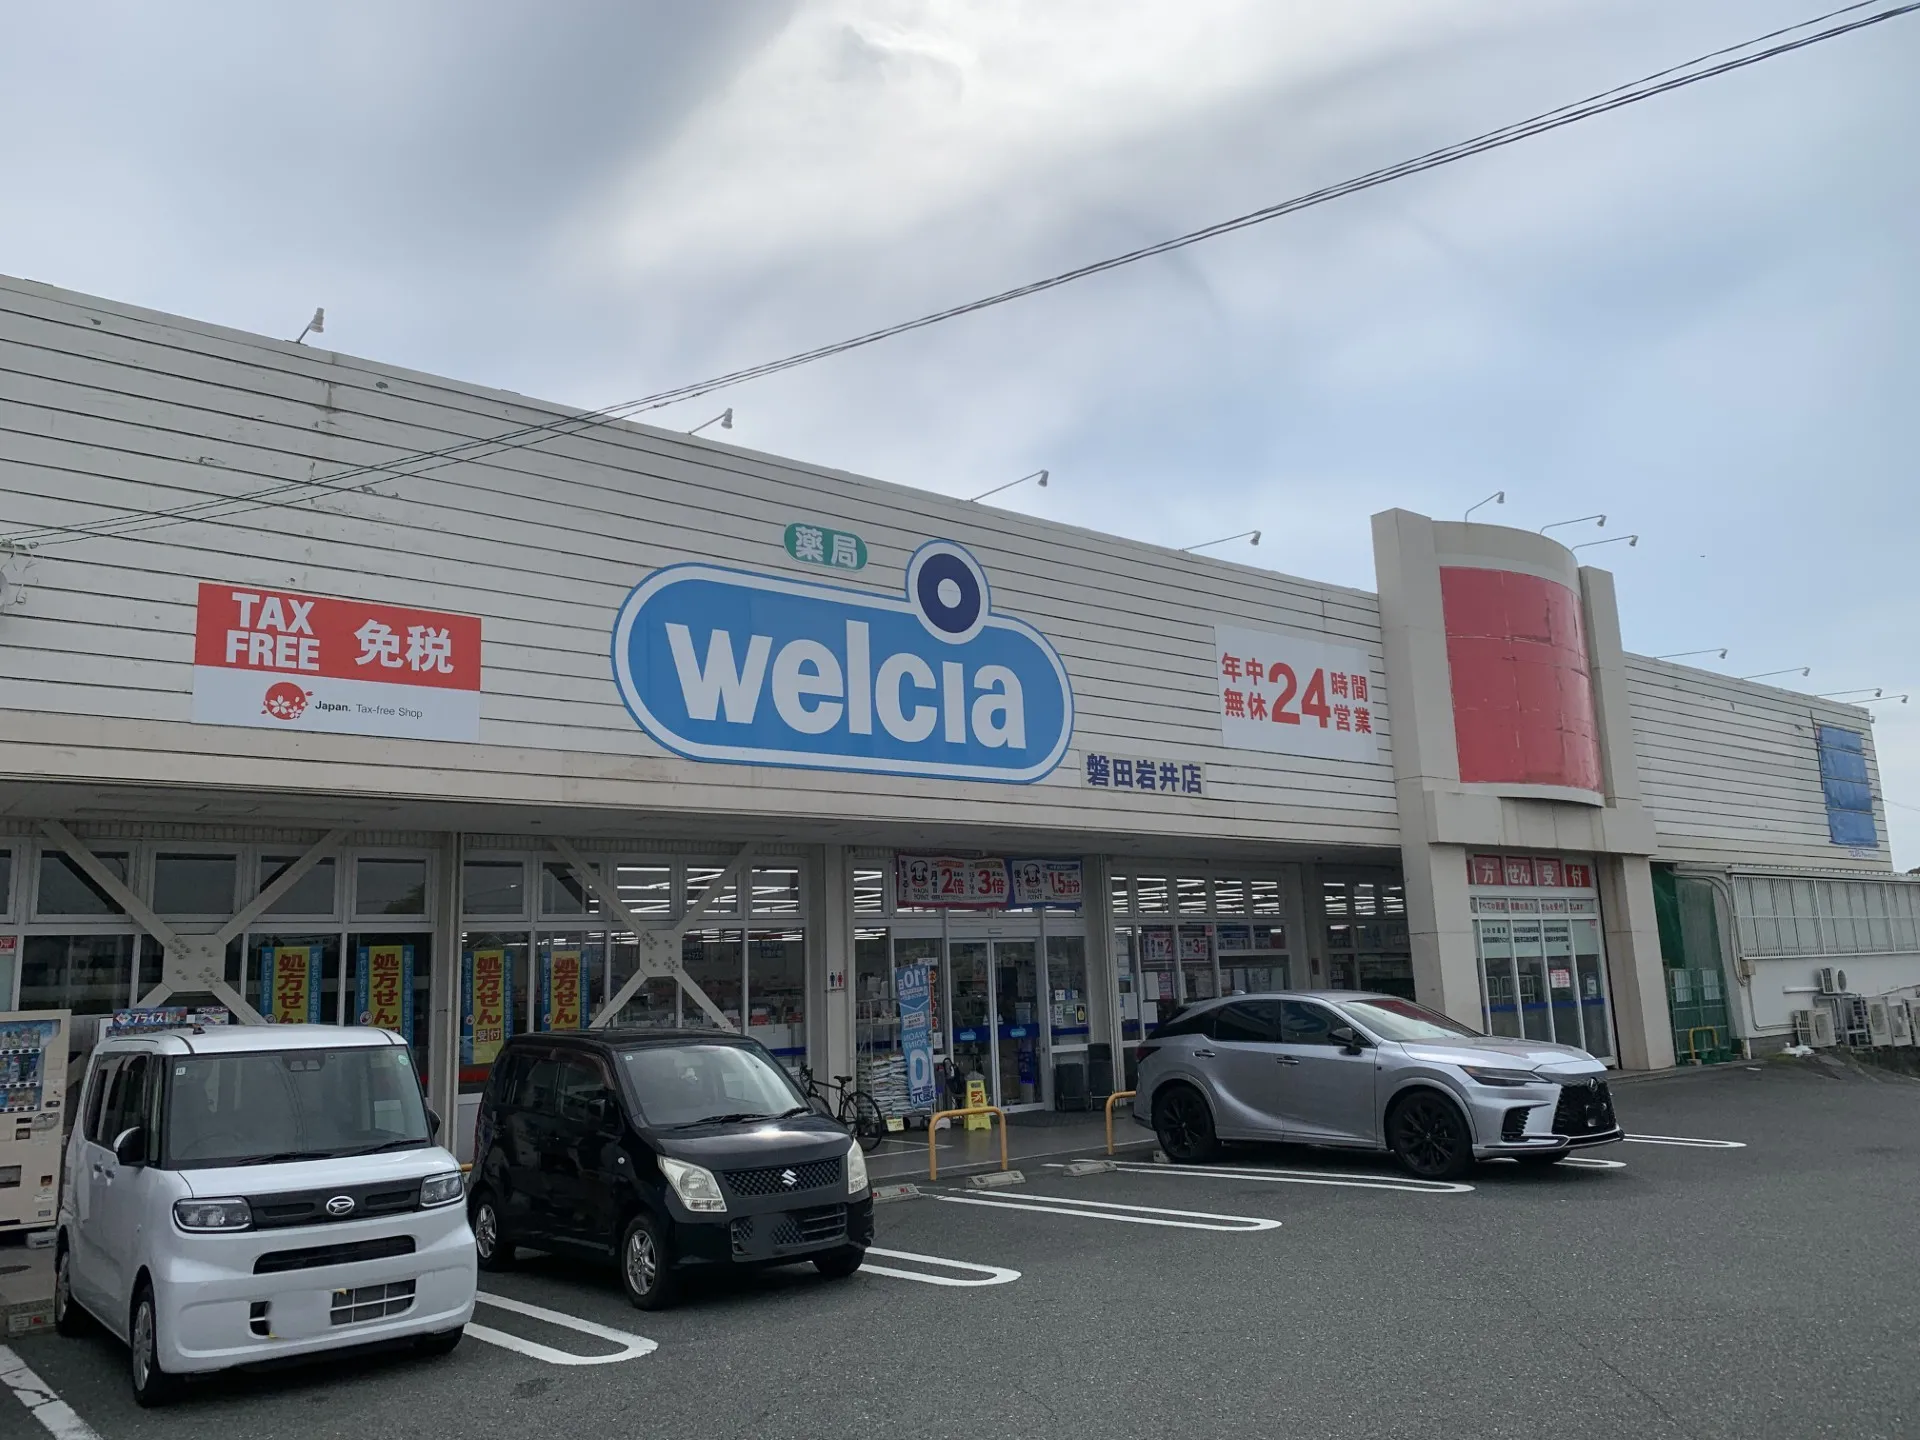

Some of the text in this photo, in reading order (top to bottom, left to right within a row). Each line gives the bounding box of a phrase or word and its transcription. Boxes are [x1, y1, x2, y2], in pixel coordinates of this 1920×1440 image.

[794, 527, 858, 567] 薬局
[232, 591, 315, 635] TAX
[225, 631, 321, 671] FREE
[354, 619, 455, 675] 免税
[665, 555, 1028, 750] welcia
[1221, 652, 1265, 687] 年中
[1330, 671, 1369, 703] 時間
[314, 700, 424, 721] Japan. Tax-free Shop
[1223, 687, 1269, 722] 無休
[1268, 662, 1332, 729] 24
[1333, 703, 1373, 734] 営業
[1086, 753, 1203, 794] 磐田岩井店
[977, 869, 1005, 895] 3倍
[372, 953, 400, 1025] 処方せん
[475, 956, 502, 1026] 処方せん
[553, 956, 579, 1025] 処方せん
[476, 1028, 501, 1042] 受付
